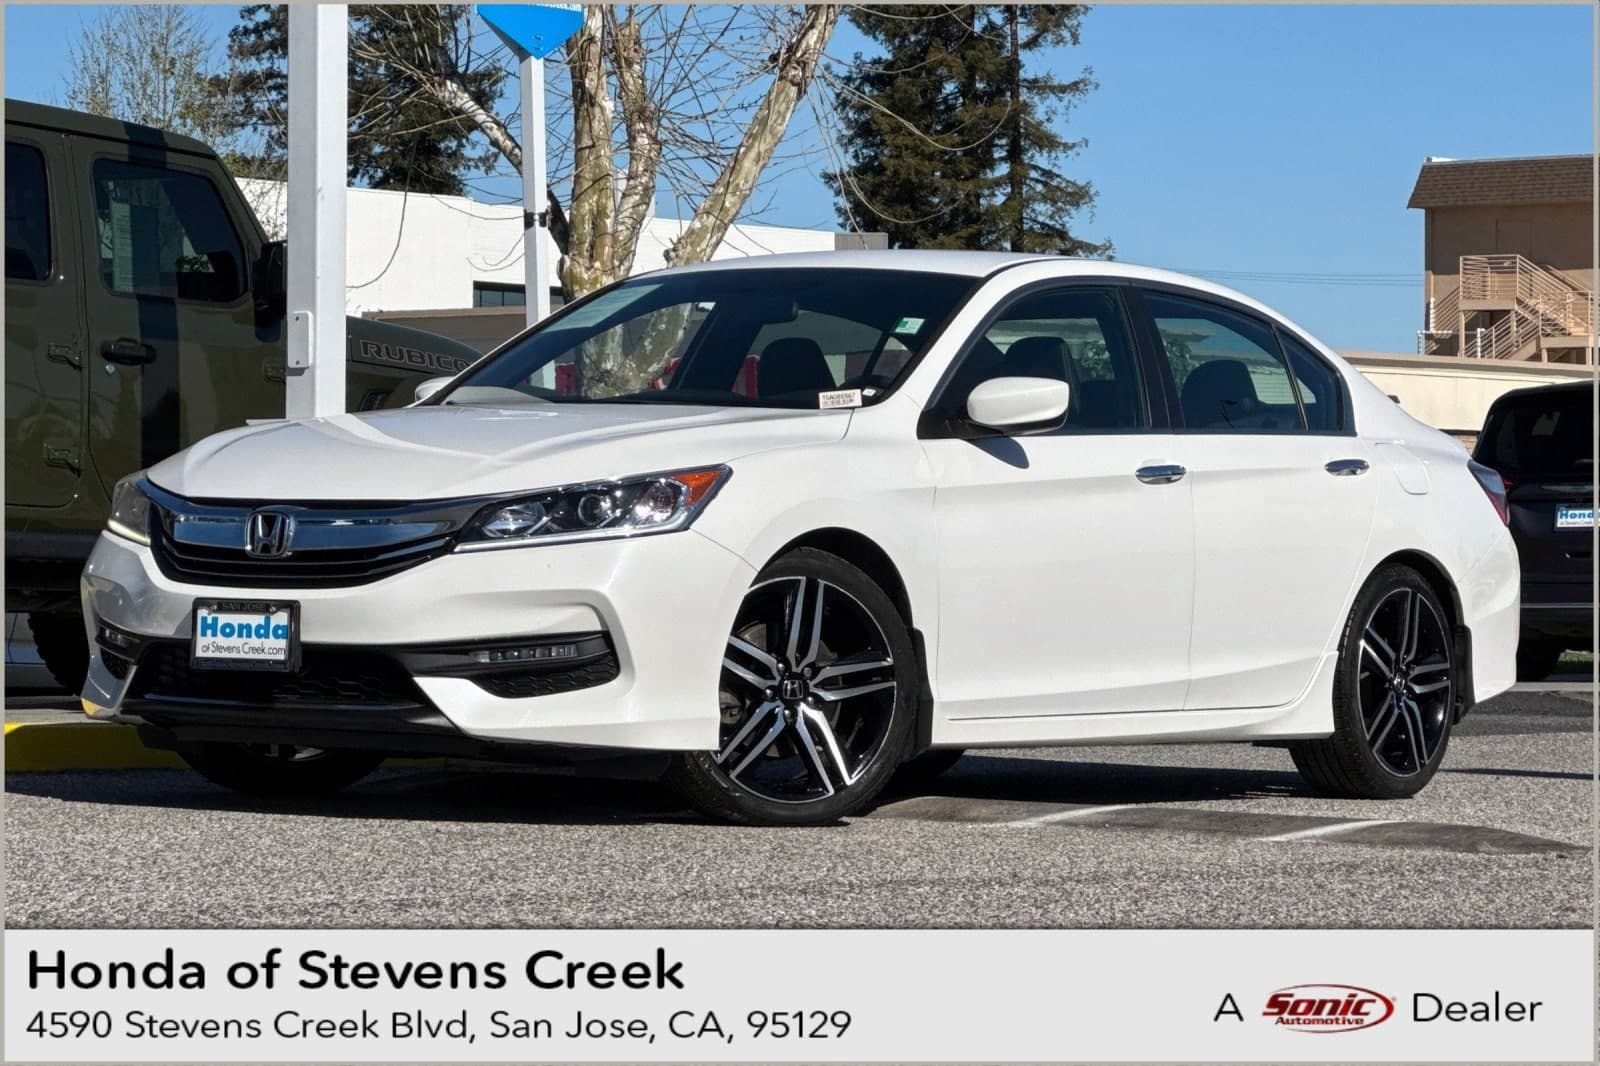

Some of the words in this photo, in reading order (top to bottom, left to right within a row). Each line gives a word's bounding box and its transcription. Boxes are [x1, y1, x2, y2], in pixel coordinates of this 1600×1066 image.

[360, 340, 473, 373] RUBICO
[200, 615, 288, 639] Honda
[201, 643, 211, 653] of
[211, 641, 241, 654] Stevens
[241, 641, 287, 656] Creek.com
